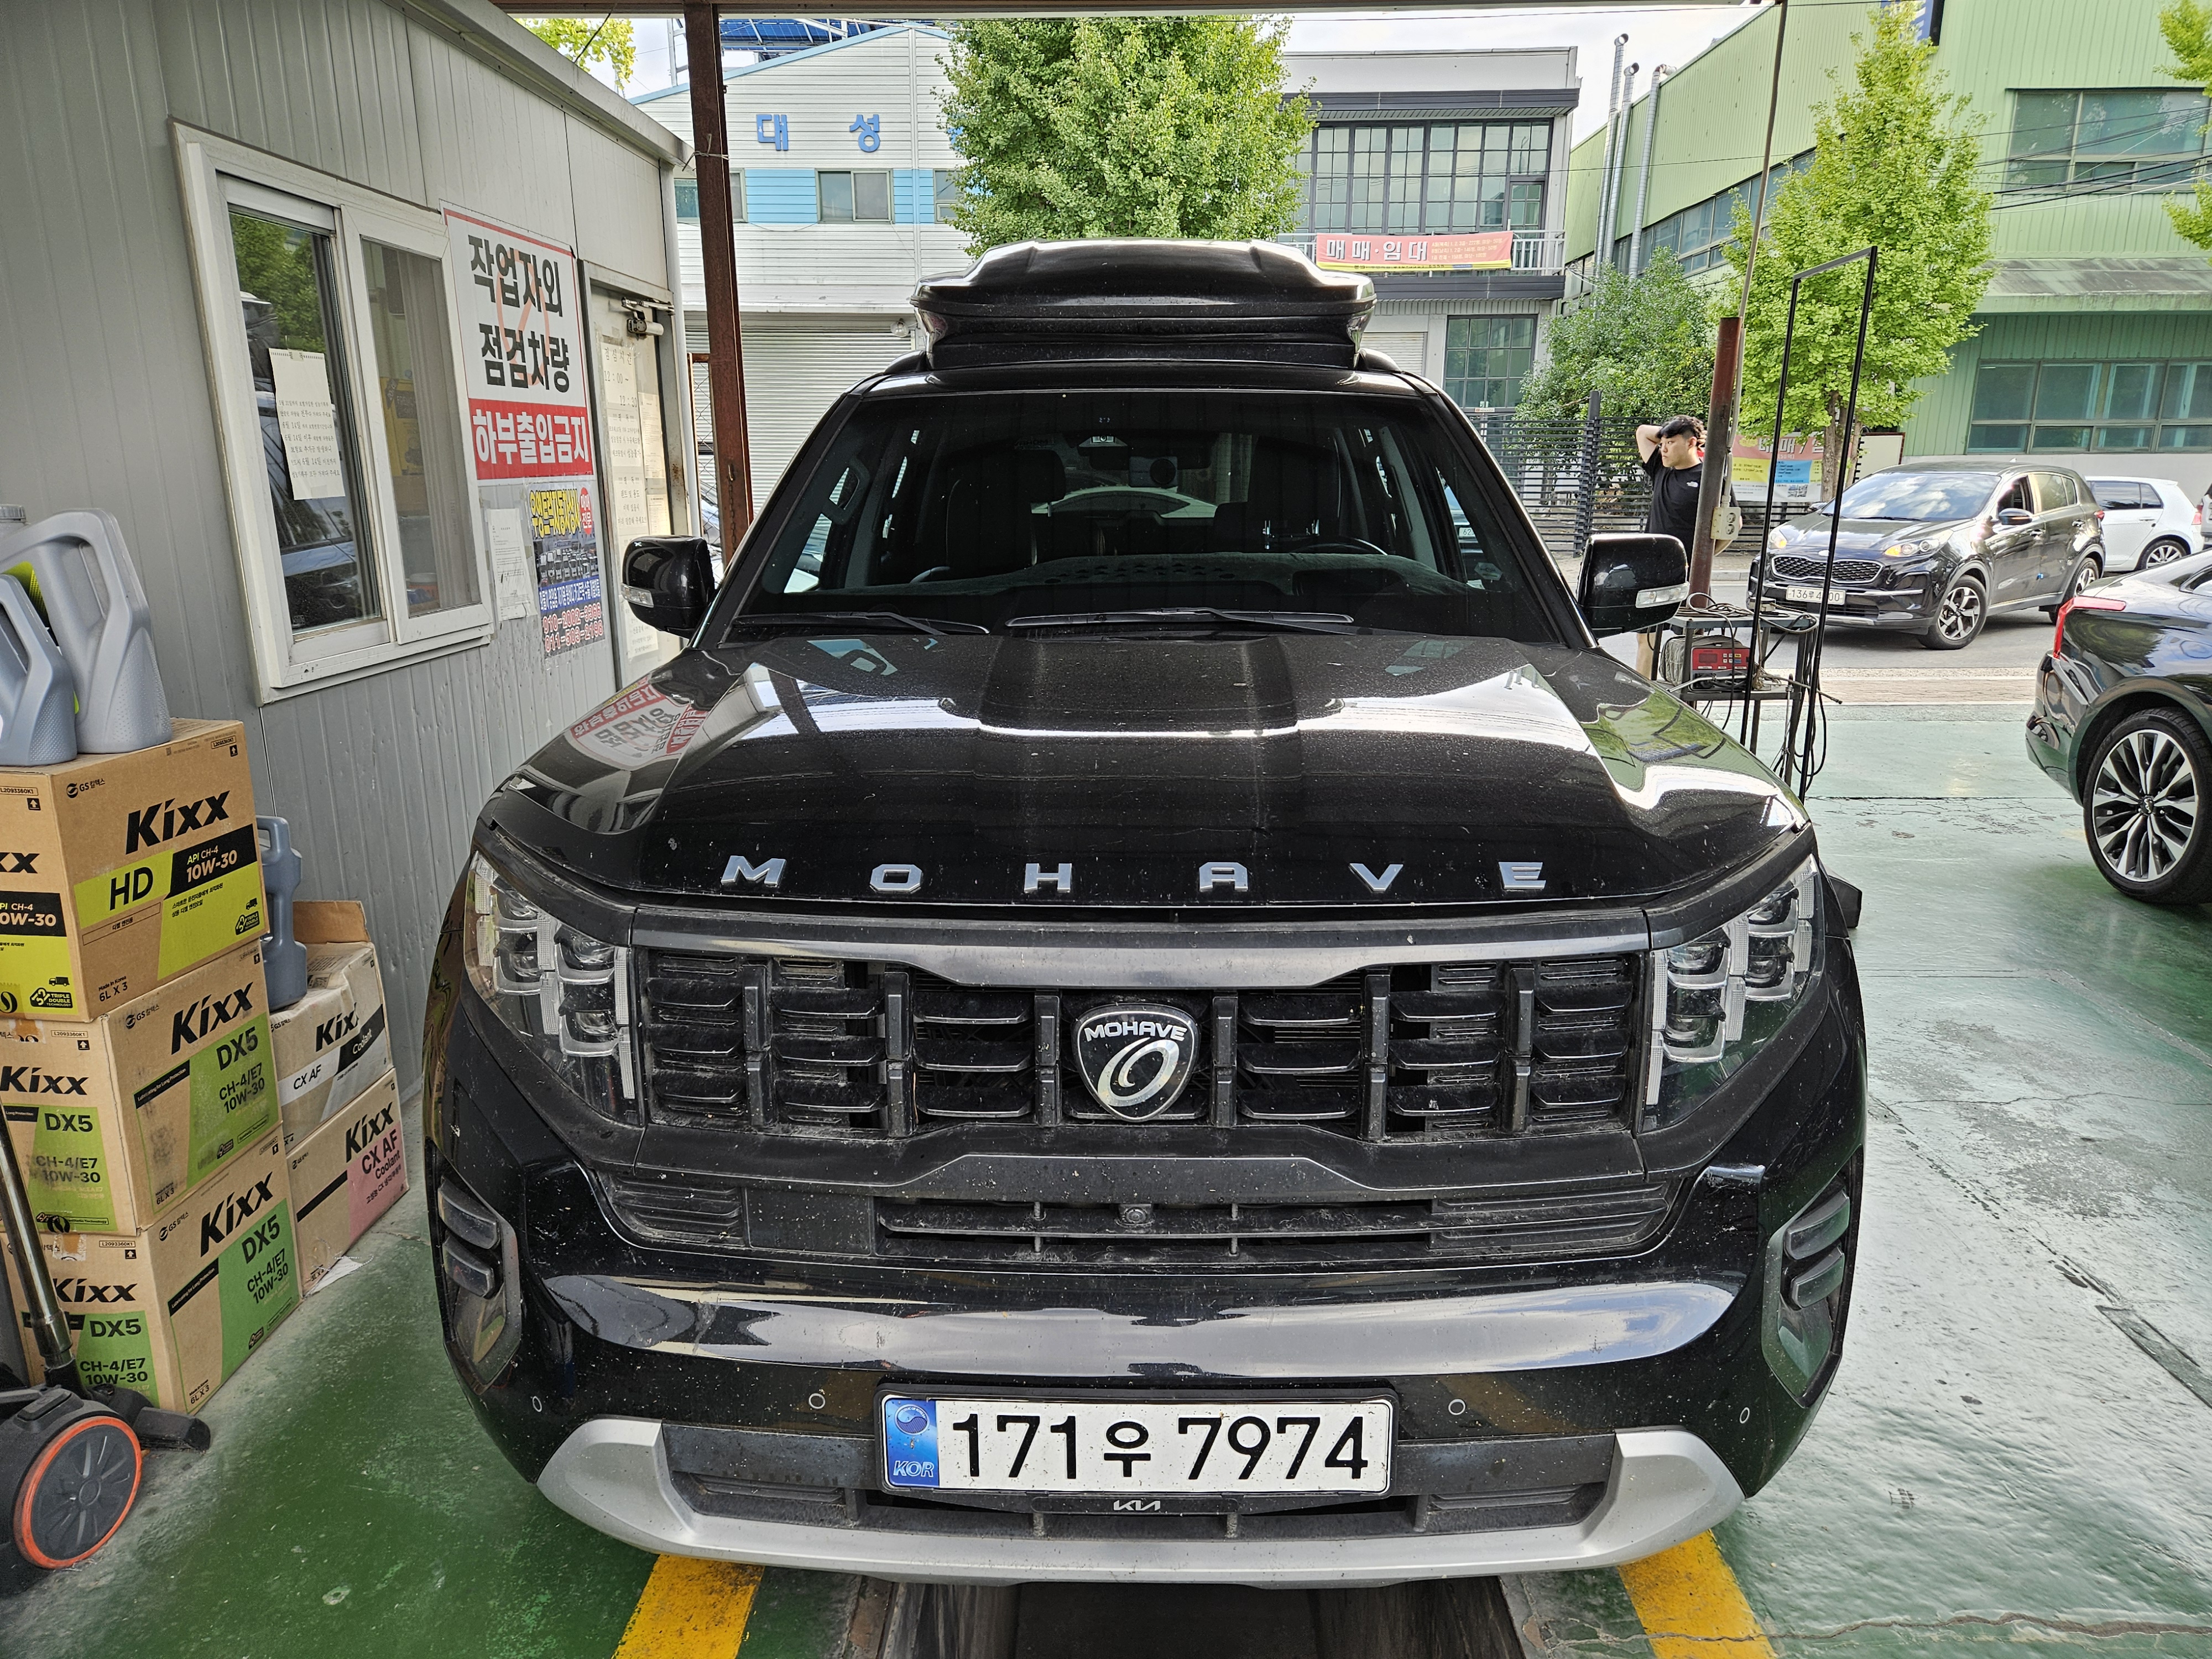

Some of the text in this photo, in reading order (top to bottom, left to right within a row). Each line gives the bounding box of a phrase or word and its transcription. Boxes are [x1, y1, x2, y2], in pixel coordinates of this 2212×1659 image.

[468, 234, 563, 317] 작업자외
[478, 323, 570, 393] 점검차량
[283, 421, 290, 429] 6월
[473, 409, 589, 465] 하부출입금지
[302, 457, 310, 466] 6월
[311, 457, 322, 465] 14일
[125, 790, 230, 854] Kixx
[186, 850, 237, 883] 10W-30
[187, 845, 218, 865] API CH-4
[720, 854, 1547, 893] MOHAVE
[109, 867, 153, 910] HD
[98, 982, 110, 991] Made
[114, 975, 127, 984] Korea
[100, 991, 111, 1002] 6L
[123, 982, 128, 990] 3
[171, 982, 254, 1055] Kixx
[1084, 1021, 1188, 1042] MOHAVE
[216, 1026, 259, 1071] DX5
[352, 1028, 372, 1054] Coolant
[0, 1066, 89, 1095] Kixx
[219, 1062, 262, 1100] CH-4/E7
[293, 1073, 307, 1090] CX
[309, 1065, 322, 1082] AF
[224, 1078, 265, 1113] 10W-30
[44, 1113, 93, 1132] DX5
[346, 1102, 394, 1163] Kixx
[35, 1155, 98, 1169] CH-4/E7
[361, 1129, 398, 1175] CX AF
[375, 1150, 400, 1180] Coolant
[42, 1170, 101, 1183] 10W-30
[156, 1197, 165, 1205] 6L
[201, 1171, 273, 1258] Kixx
[242, 1214, 280, 1264] DX5
[247, 1248, 285, 1292] CH-4/E7
[253, 1263, 288, 1303] 10W-30
[53, 1278, 138, 1303] Kixx
[90, 1318, 142, 1338] DX5
[80, 1358, 146, 1372] CH-4/E7
[85, 1371, 148, 1385] 10W-30
[190, 1395, 200, 1404] 6L
[893, 1460, 935, 1478] KOR
